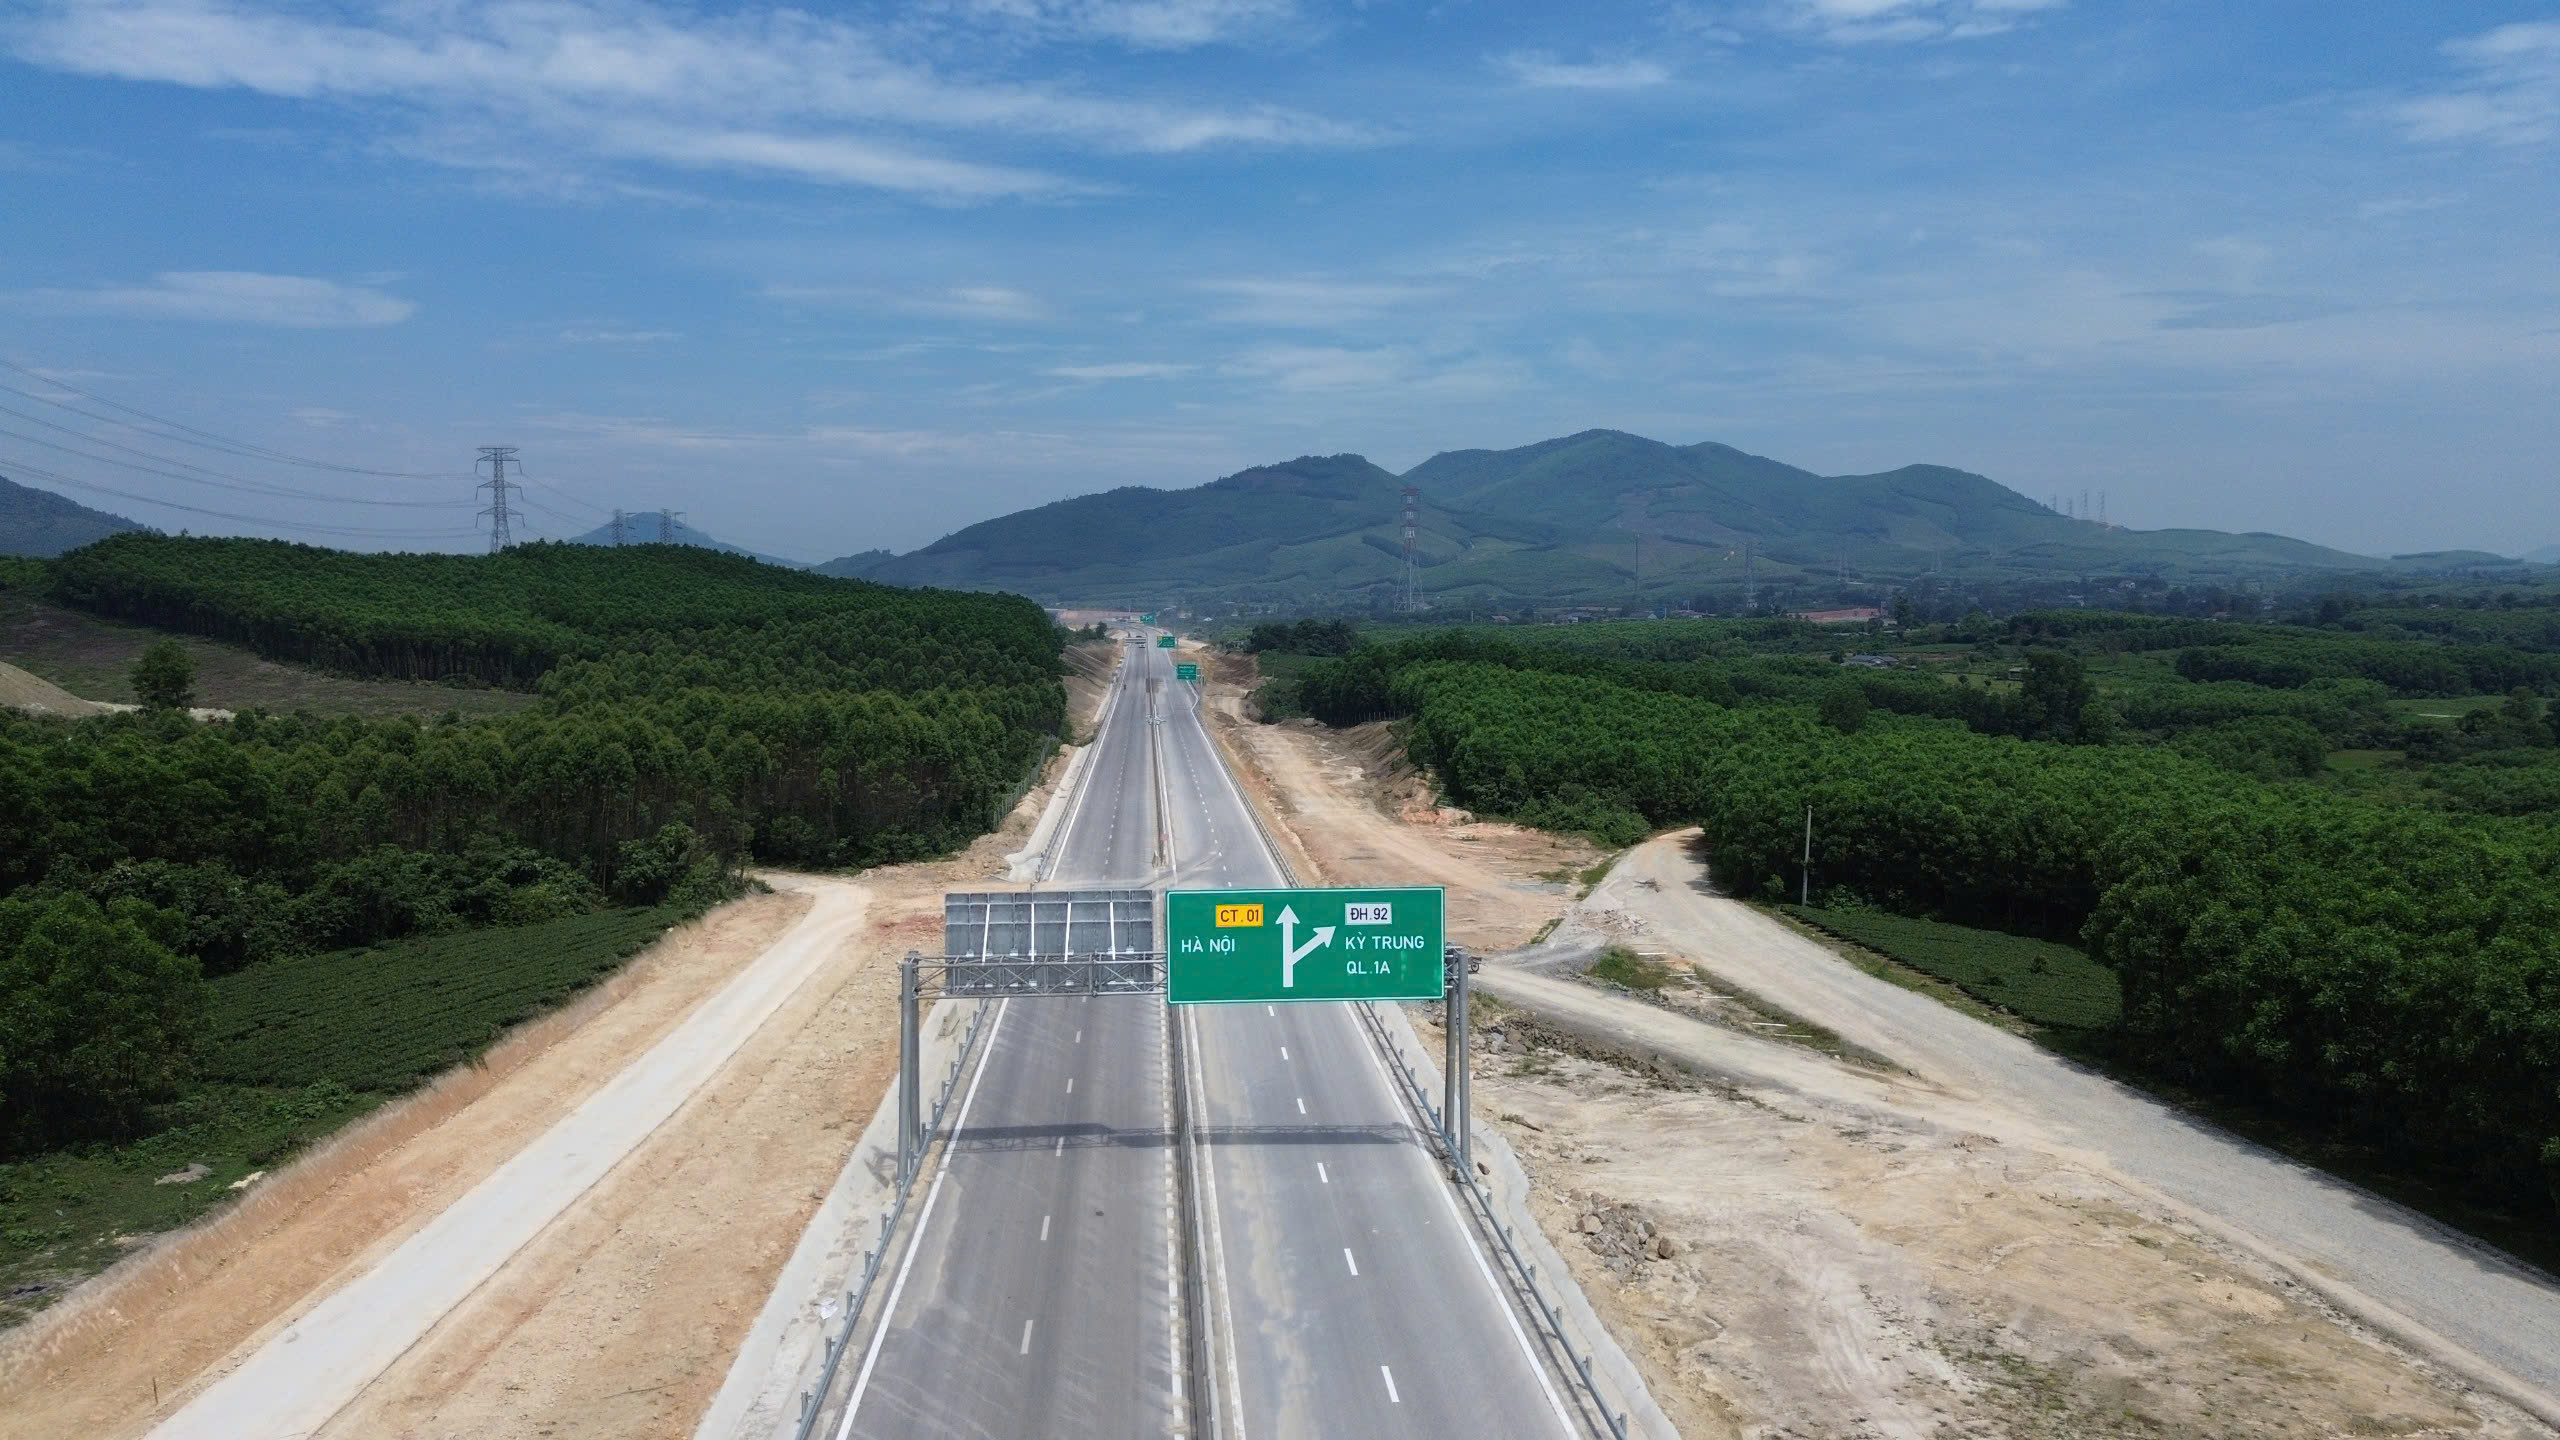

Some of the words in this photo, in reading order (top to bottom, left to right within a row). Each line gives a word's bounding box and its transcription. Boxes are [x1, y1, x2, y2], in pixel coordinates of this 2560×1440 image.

[1220, 908, 1260, 923] CT.01
[1350, 907, 1388, 921] ĐH.92
[1181, 935, 1204, 953] HÀ
[1209, 935, 1236, 956] NỘI
[1345, 935, 1366, 950] KỲ
[1372, 935, 1425, 950] TRUNG
[1346, 961, 1391, 975] QL.1A
